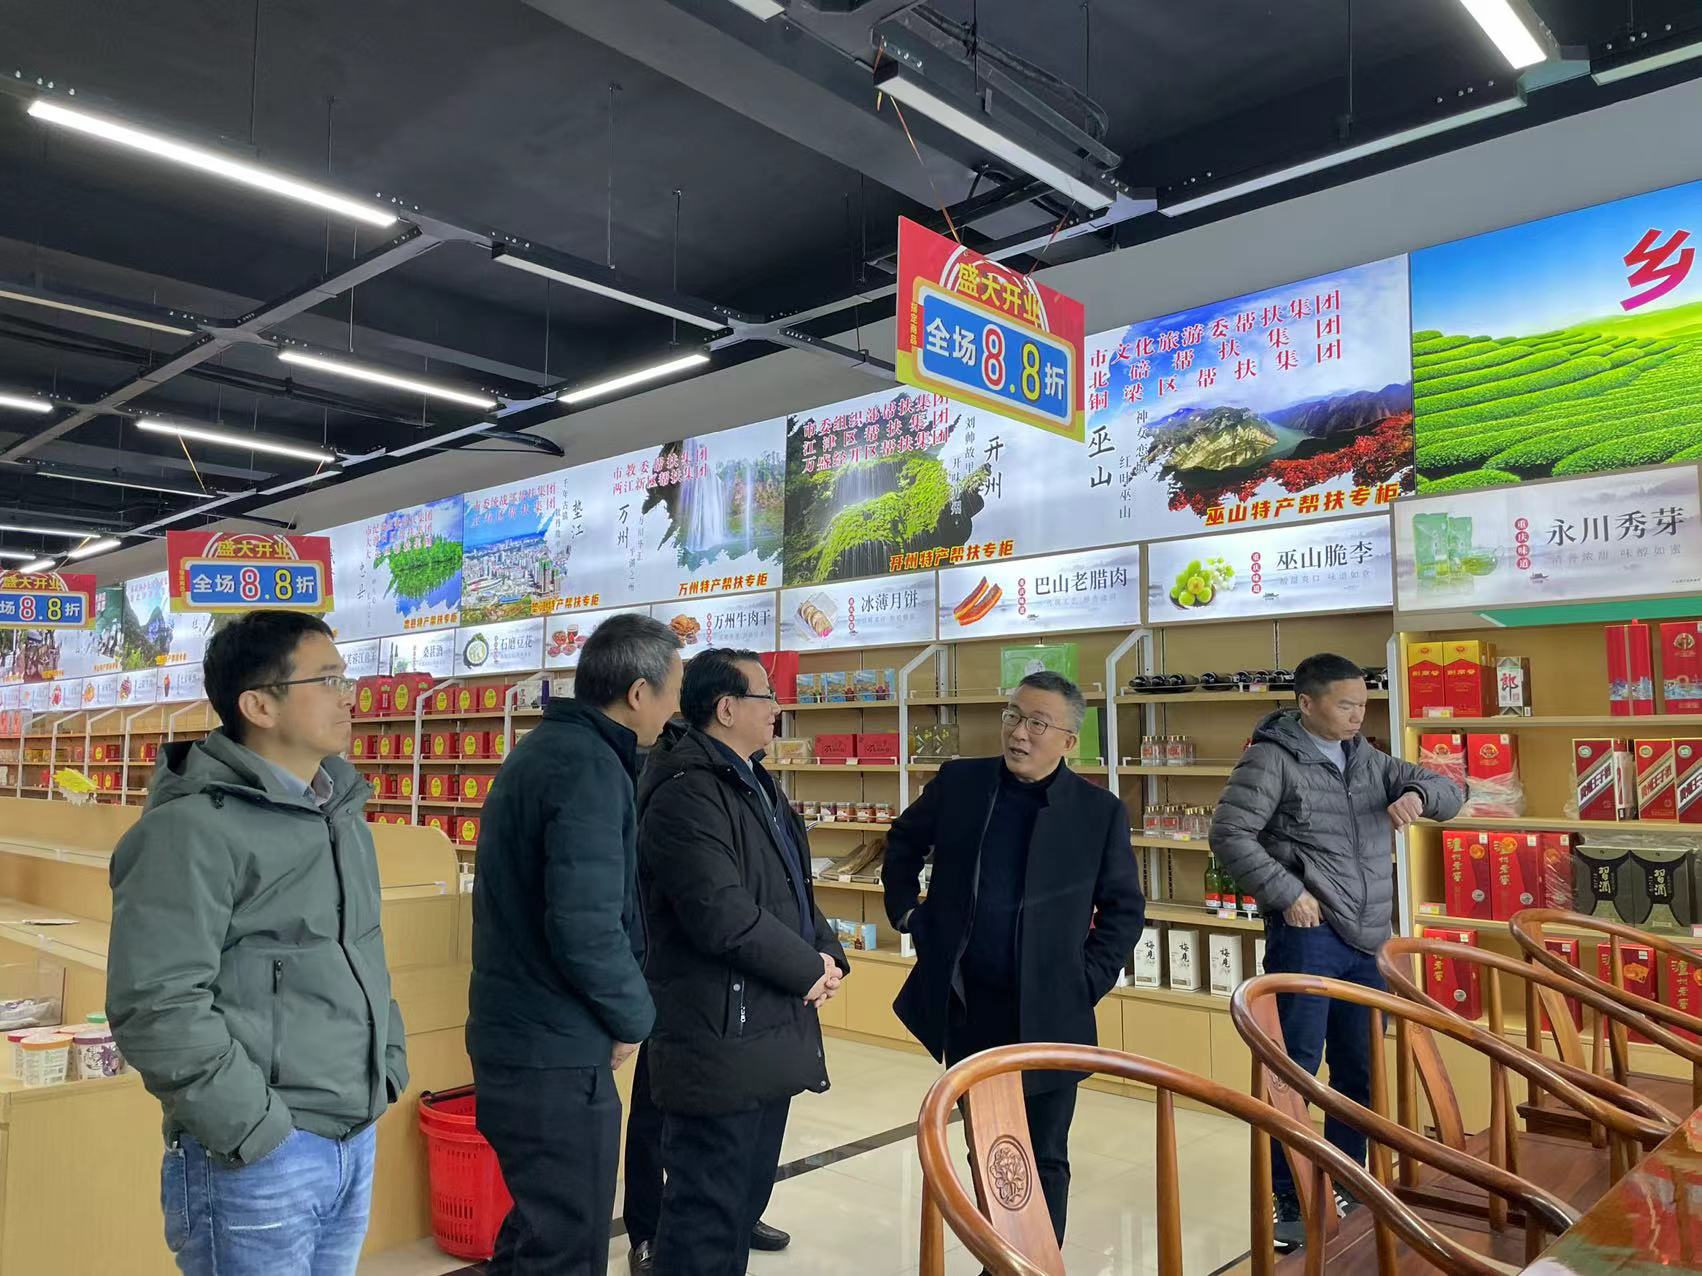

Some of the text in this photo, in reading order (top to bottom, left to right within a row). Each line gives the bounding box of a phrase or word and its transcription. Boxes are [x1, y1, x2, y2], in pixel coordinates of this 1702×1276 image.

[958, 262, 1040, 322] 盛大开业
[1619, 228, 1696, 312] 乡
[1090, 290, 1341, 368] 市文化旅游委帮扶集团
[1088, 339, 1341, 410] 铜梁区帮扶集团
[803, 393, 949, 438] 市委组织部帮扶集团
[803, 408, 949, 456] 江津区帮扶集团
[802, 428, 950, 473] 万盛经开区帮扶集团
[984, 436, 1004, 499] 开州
[1088, 425, 1115, 489] 巫山
[617, 503, 630, 549] 万州
[1205, 482, 1399, 527] 巫山特产帮扶专柜
[1546, 506, 1684, 546] 永川秀芽
[217, 540, 290, 558] 盛大开业
[889, 539, 1015, 573] 开州特产帮扶专柜
[1276, 541, 1374, 571] 巫山脆李
[3, 576, 61, 590] 盛大开业
[678, 572, 768, 596] 万州特产帮扶专柜
[861, 590, 918, 613] 冰薄月饼
[1035, 567, 1128, 596] 巴山老腊肉
[714, 609, 771, 630] 万州牛肉干
